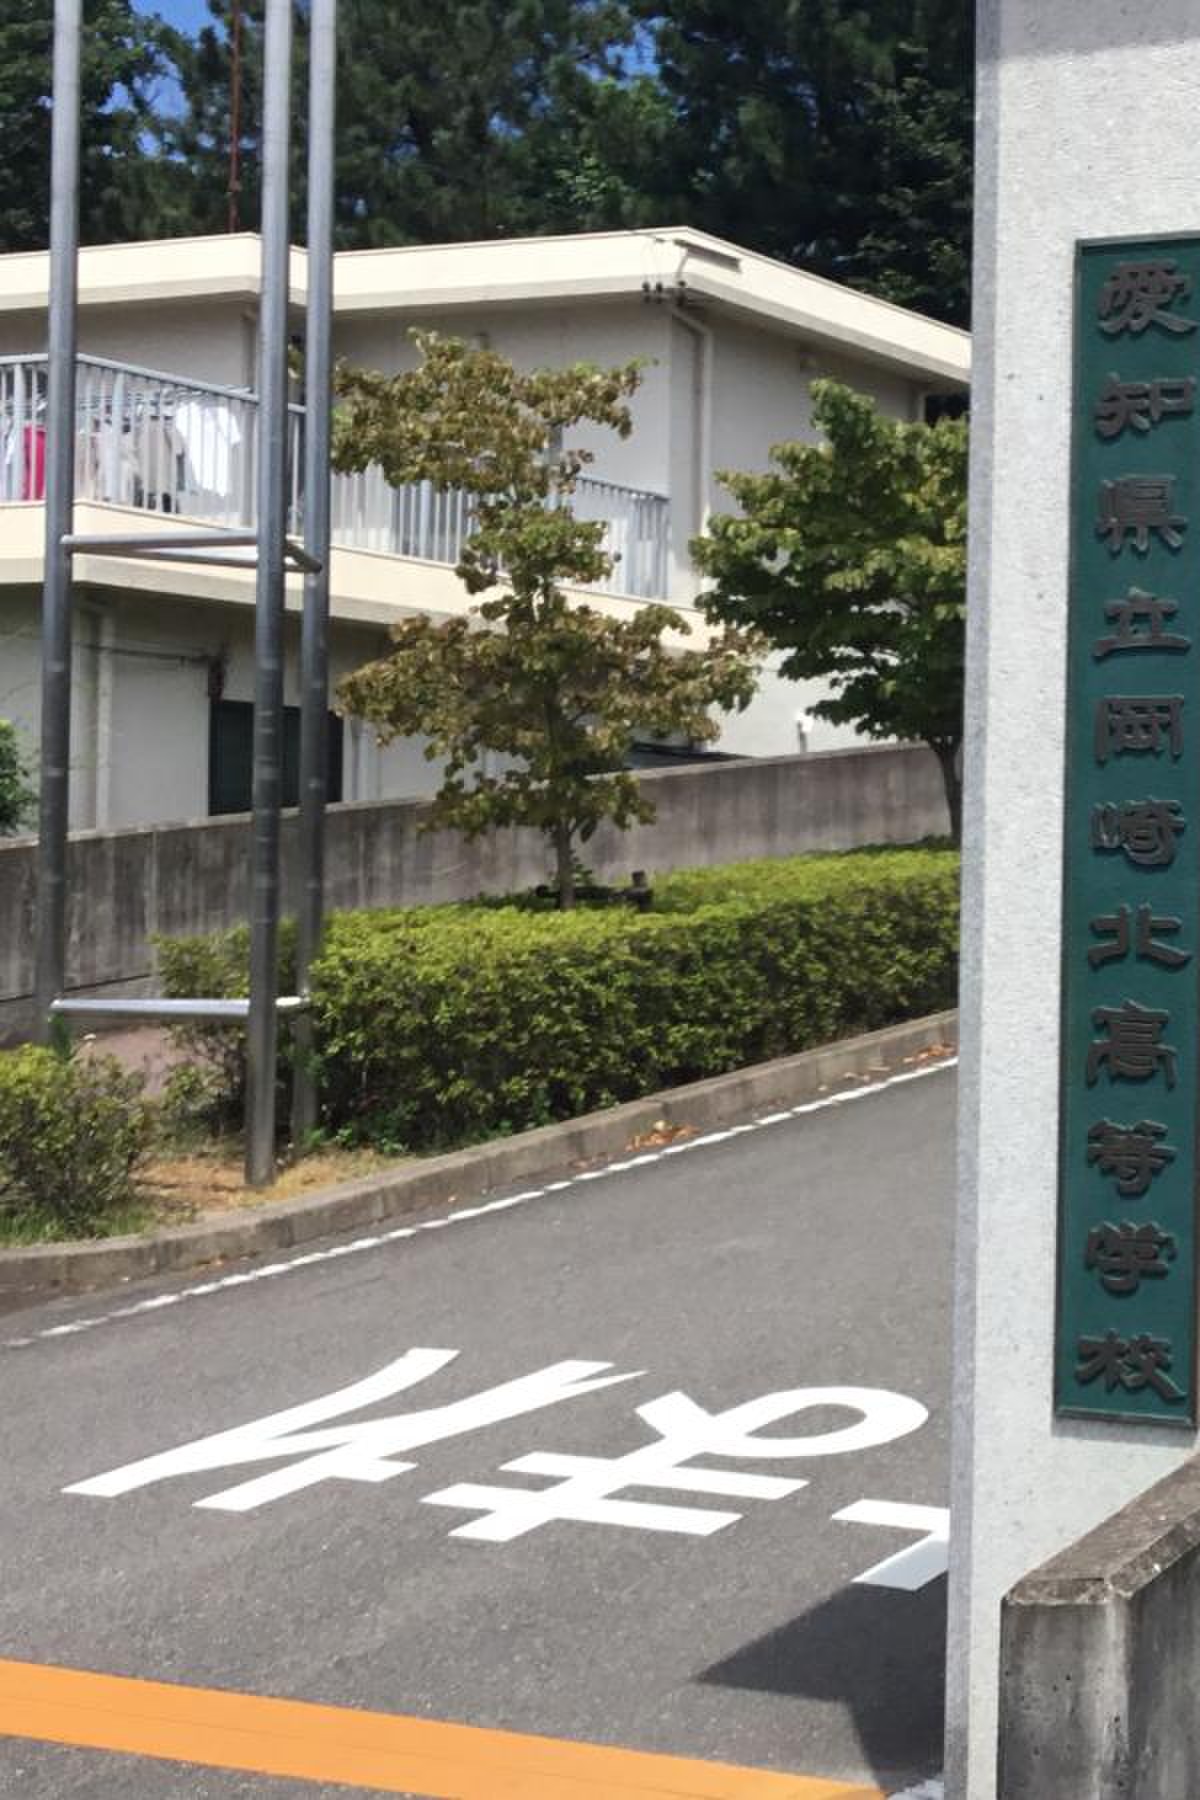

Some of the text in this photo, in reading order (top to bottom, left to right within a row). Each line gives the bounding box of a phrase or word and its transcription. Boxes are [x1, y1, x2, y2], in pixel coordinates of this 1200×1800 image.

[1075, 259, 1200, 1402] 愛知県立岡崎北高等学校
